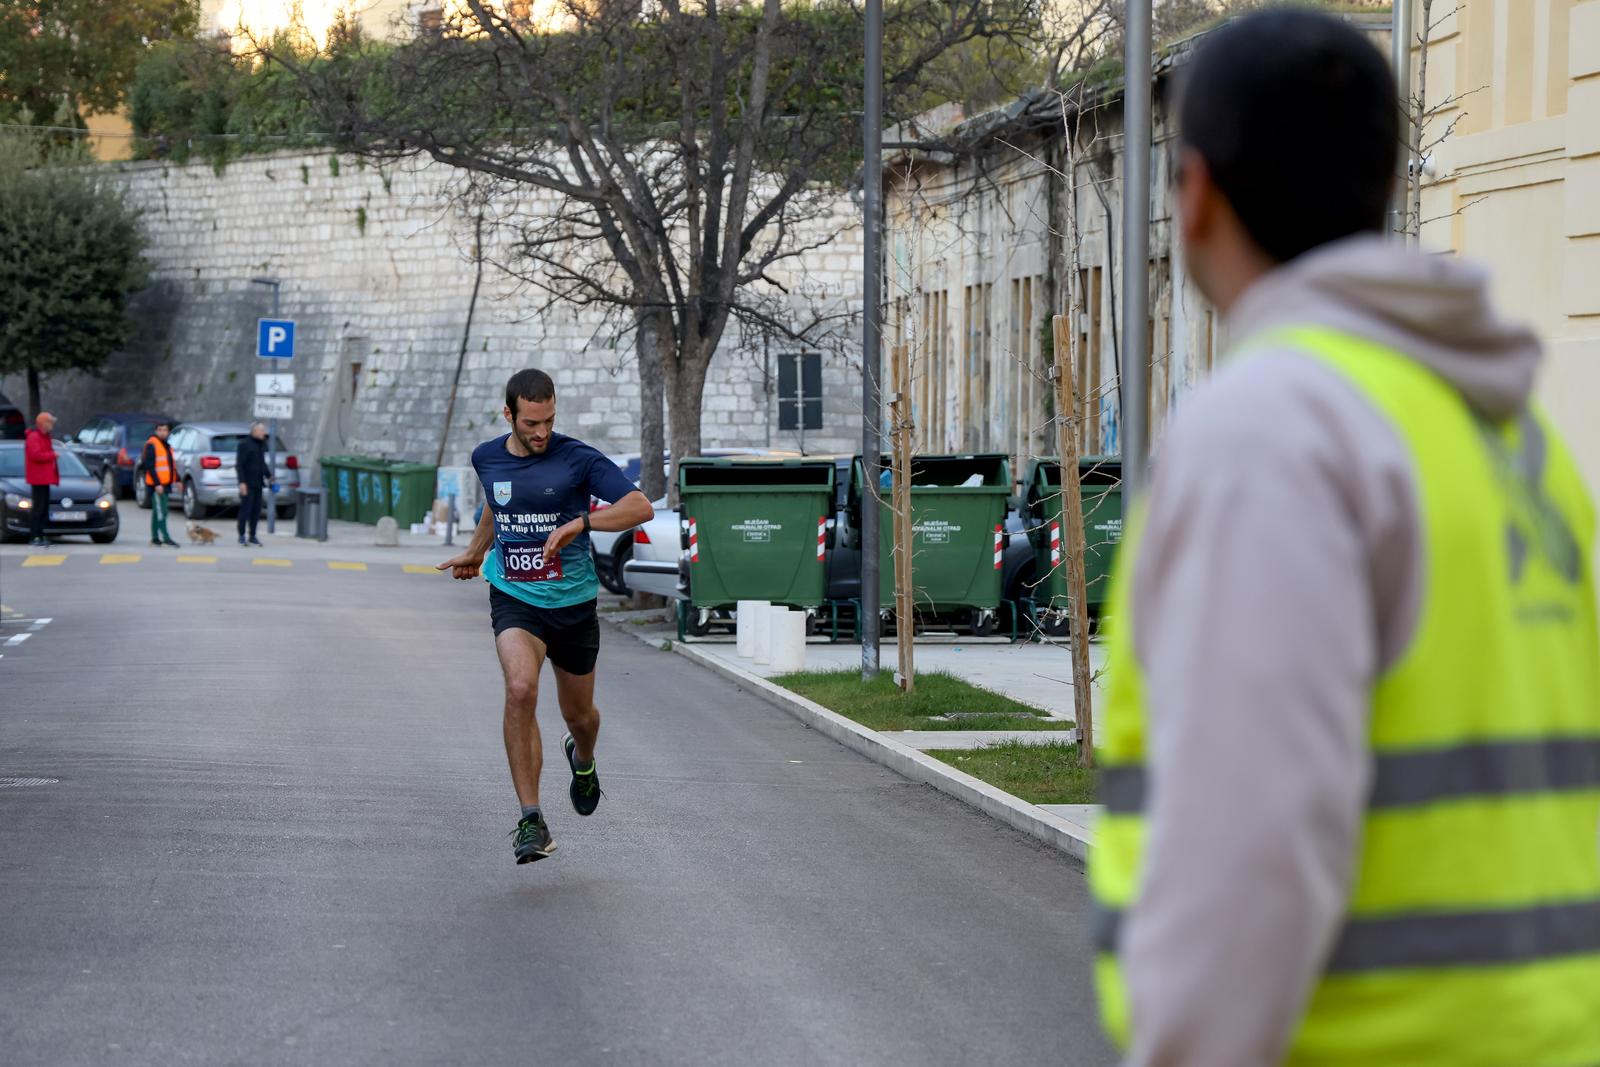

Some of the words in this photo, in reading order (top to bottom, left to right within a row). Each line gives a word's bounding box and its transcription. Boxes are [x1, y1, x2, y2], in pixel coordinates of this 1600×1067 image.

[268, 326, 286, 353] P
[512, 512, 561, 524] "ROGOVO"
[500, 524, 510, 532] Sv.
[511, 525, 528, 534] Filip
[535, 524, 557, 533] Jakov
